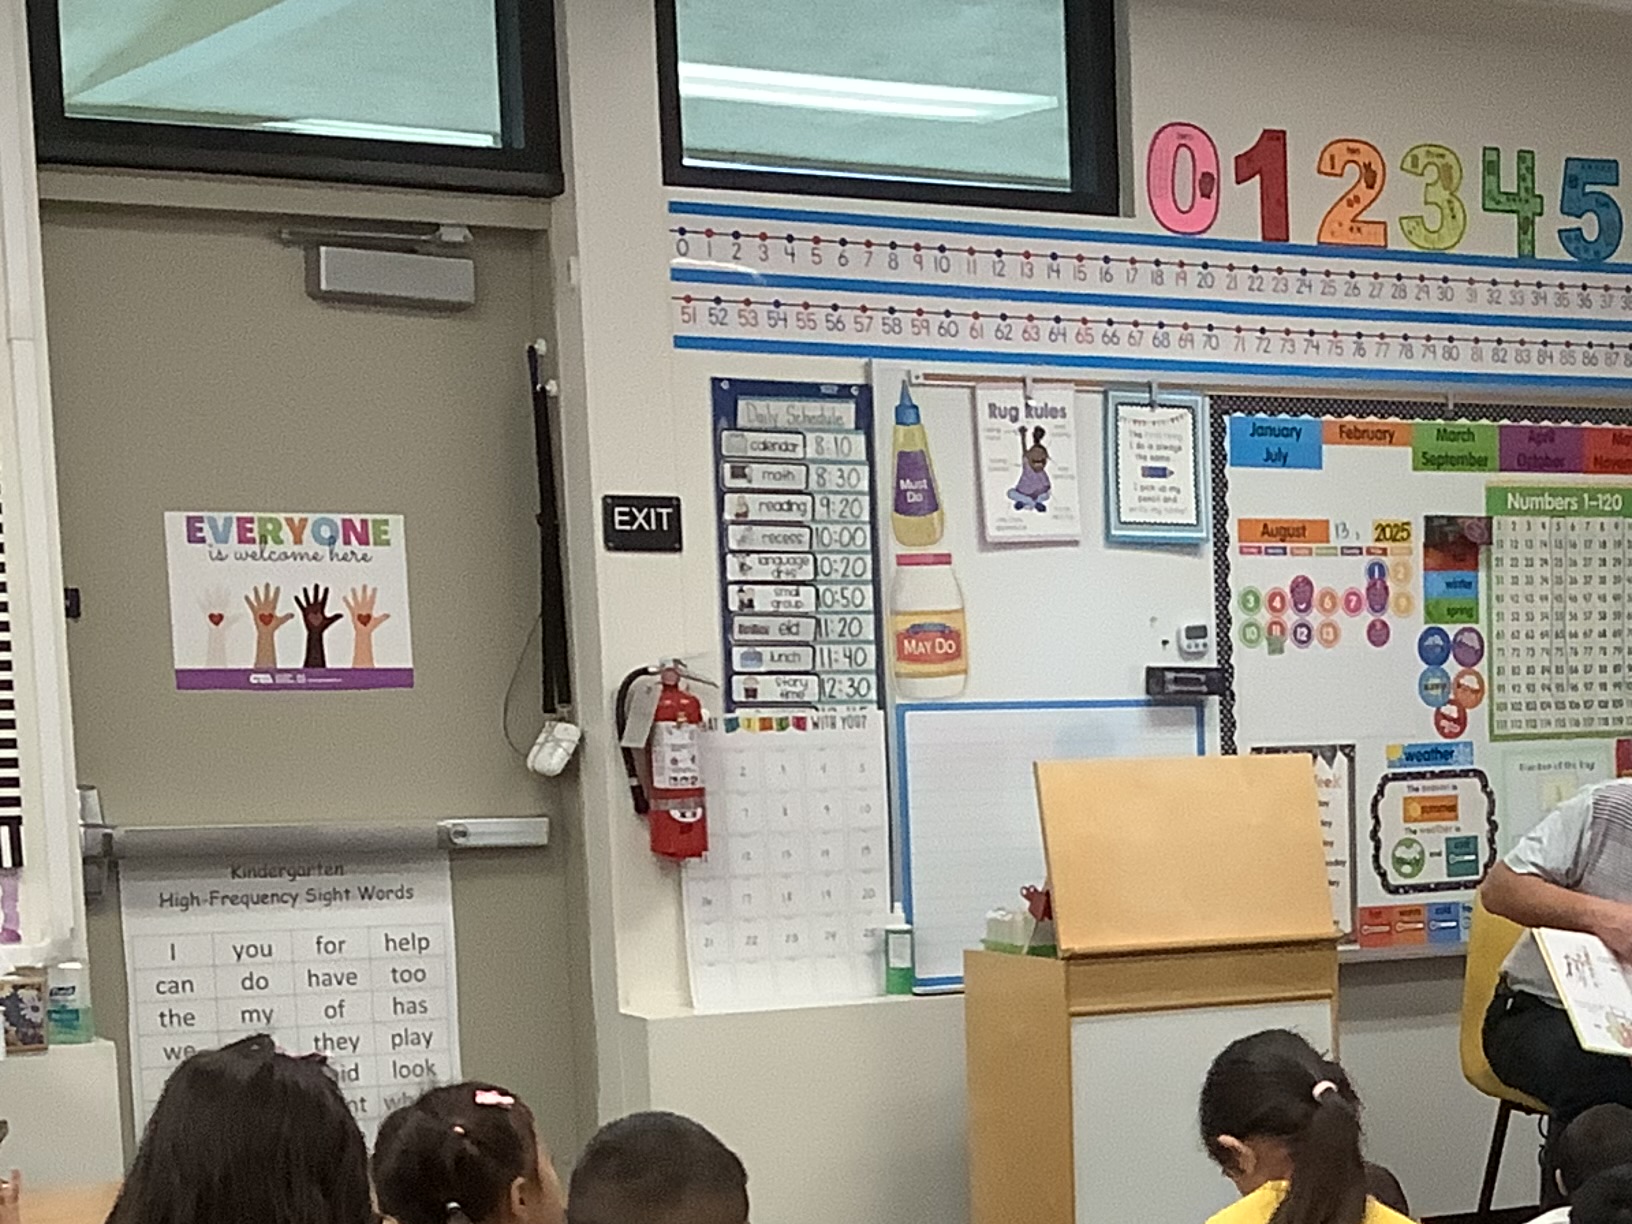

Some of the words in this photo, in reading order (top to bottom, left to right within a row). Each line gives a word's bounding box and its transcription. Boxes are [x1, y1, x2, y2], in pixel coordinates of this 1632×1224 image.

[1147, 121, 1220, 235] 0
[1234, 129, 1289, 242] 1
[1317, 138, 1388, 248] 2
[1398, 143, 1468, 251] 3
[1481, 146, 1544, 259] 4
[1558, 157, 1623, 262] 5
[676, 238, 689, 257] 0
[758, 244, 769, 261] 3
[811, 247, 822, 265] 5
[838, 249, 849, 267] 6
[933, 255, 950, 274] 10
[746, 401, 779, 430] Daily
[787, 404, 844, 426] Schedule
[988, 402, 1020, 423] Rug
[1249, 422, 1302, 441] January
[1339, 425, 1396, 444] February
[1436, 428, 1476, 442] March
[749, 439, 800, 452] calendar
[814, 435, 853, 457] 8:10
[1262, 447, 1289, 466] July
[1421, 451, 1490, 470] September
[762, 469, 796, 481] math
[816, 466, 861, 489] 8:30
[900, 478, 928, 490] Must
[759, 499, 808, 517] reading
[819, 496, 863, 519] 9:20
[906, 491, 924, 503] Do
[1507, 491, 1578, 511] Numbers
[614, 507, 673, 530] EXIT
[185, 515, 391, 547] EVERYONE
[761, 533, 804, 545] recess
[815, 526, 867, 548] 10:00
[1261, 522, 1307, 542] August
[1374, 521, 1411, 542] 2025
[208, 543, 229, 562] is
[235, 534, 324, 562] welcome
[328, 534, 374, 563] here
[818, 616, 863, 638] 11:20
[770, 651, 802, 663] lunch
[819, 646, 868, 669] 11:40
[821, 677, 872, 699] 12:30
[1404, 748, 1455, 762] weather
[230, 861, 345, 882] Kindergarten
[159, 889, 299, 912] High-Frequency
[305, 886, 350, 907] Sight
[358, 884, 414, 901] Words
[232, 942, 273, 962] you
[315, 935, 346, 954] for
[384, 932, 430, 955] help
[156, 978, 195, 994] can
[241, 972, 269, 991] do
[307, 969, 358, 987] have
[390, 966, 427, 984] too
[159, 1009, 197, 1028] the
[241, 1006, 274, 1025] my
[324, 1000, 347, 1019] of
[392, 997, 428, 1016] has
[163, 1044, 197, 1061] we
[313, 1032, 361, 1053] they
[390, 1028, 434, 1050] play
[392, 1060, 437, 1079] look
